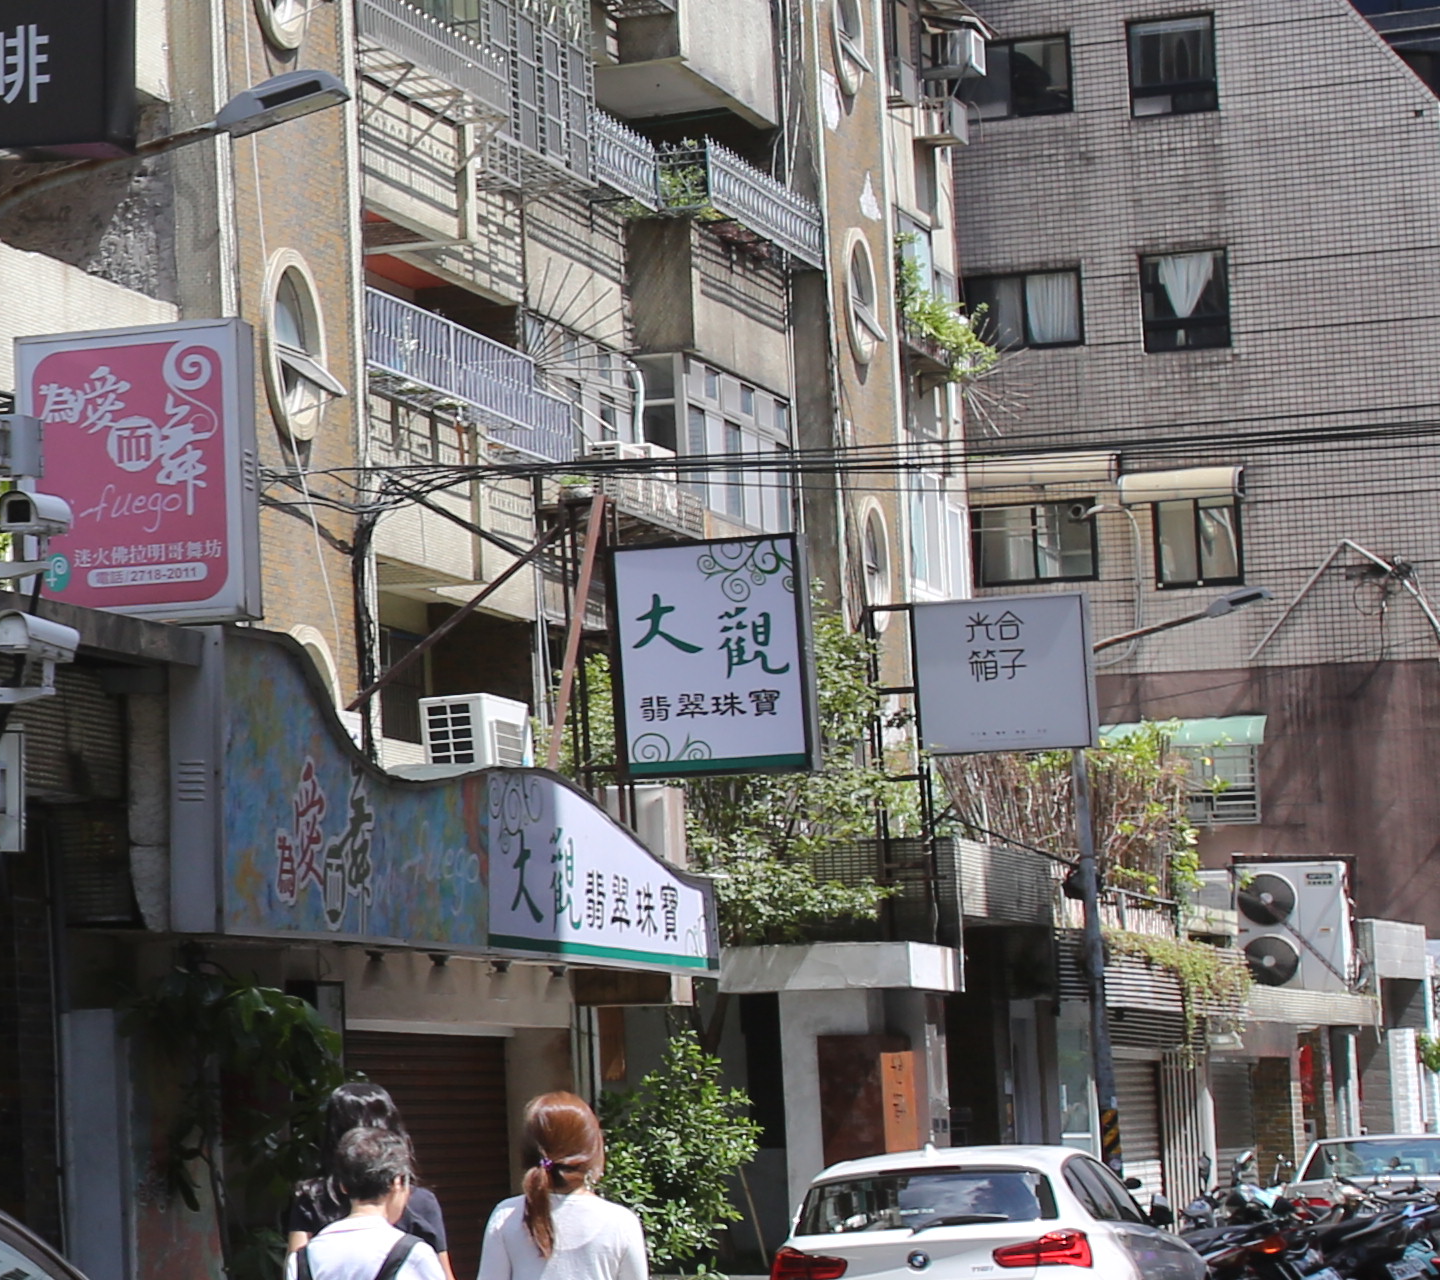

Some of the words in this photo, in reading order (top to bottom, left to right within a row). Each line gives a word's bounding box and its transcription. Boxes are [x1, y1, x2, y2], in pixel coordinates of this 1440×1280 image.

[39, 365, 214, 516] 為愛而舞
[73, 538, 222, 568] 迷火佛拉明哥舞坊
[632, 593, 790, 679] 大觀
[965, 610, 1025, 643] 光合
[968, 649, 1028, 683] 箱子
[640, 689, 780, 722] 翡翠珠寶
[511, 827, 582, 932] 大觀
[585, 870, 681, 942] 翡翠珠寶
